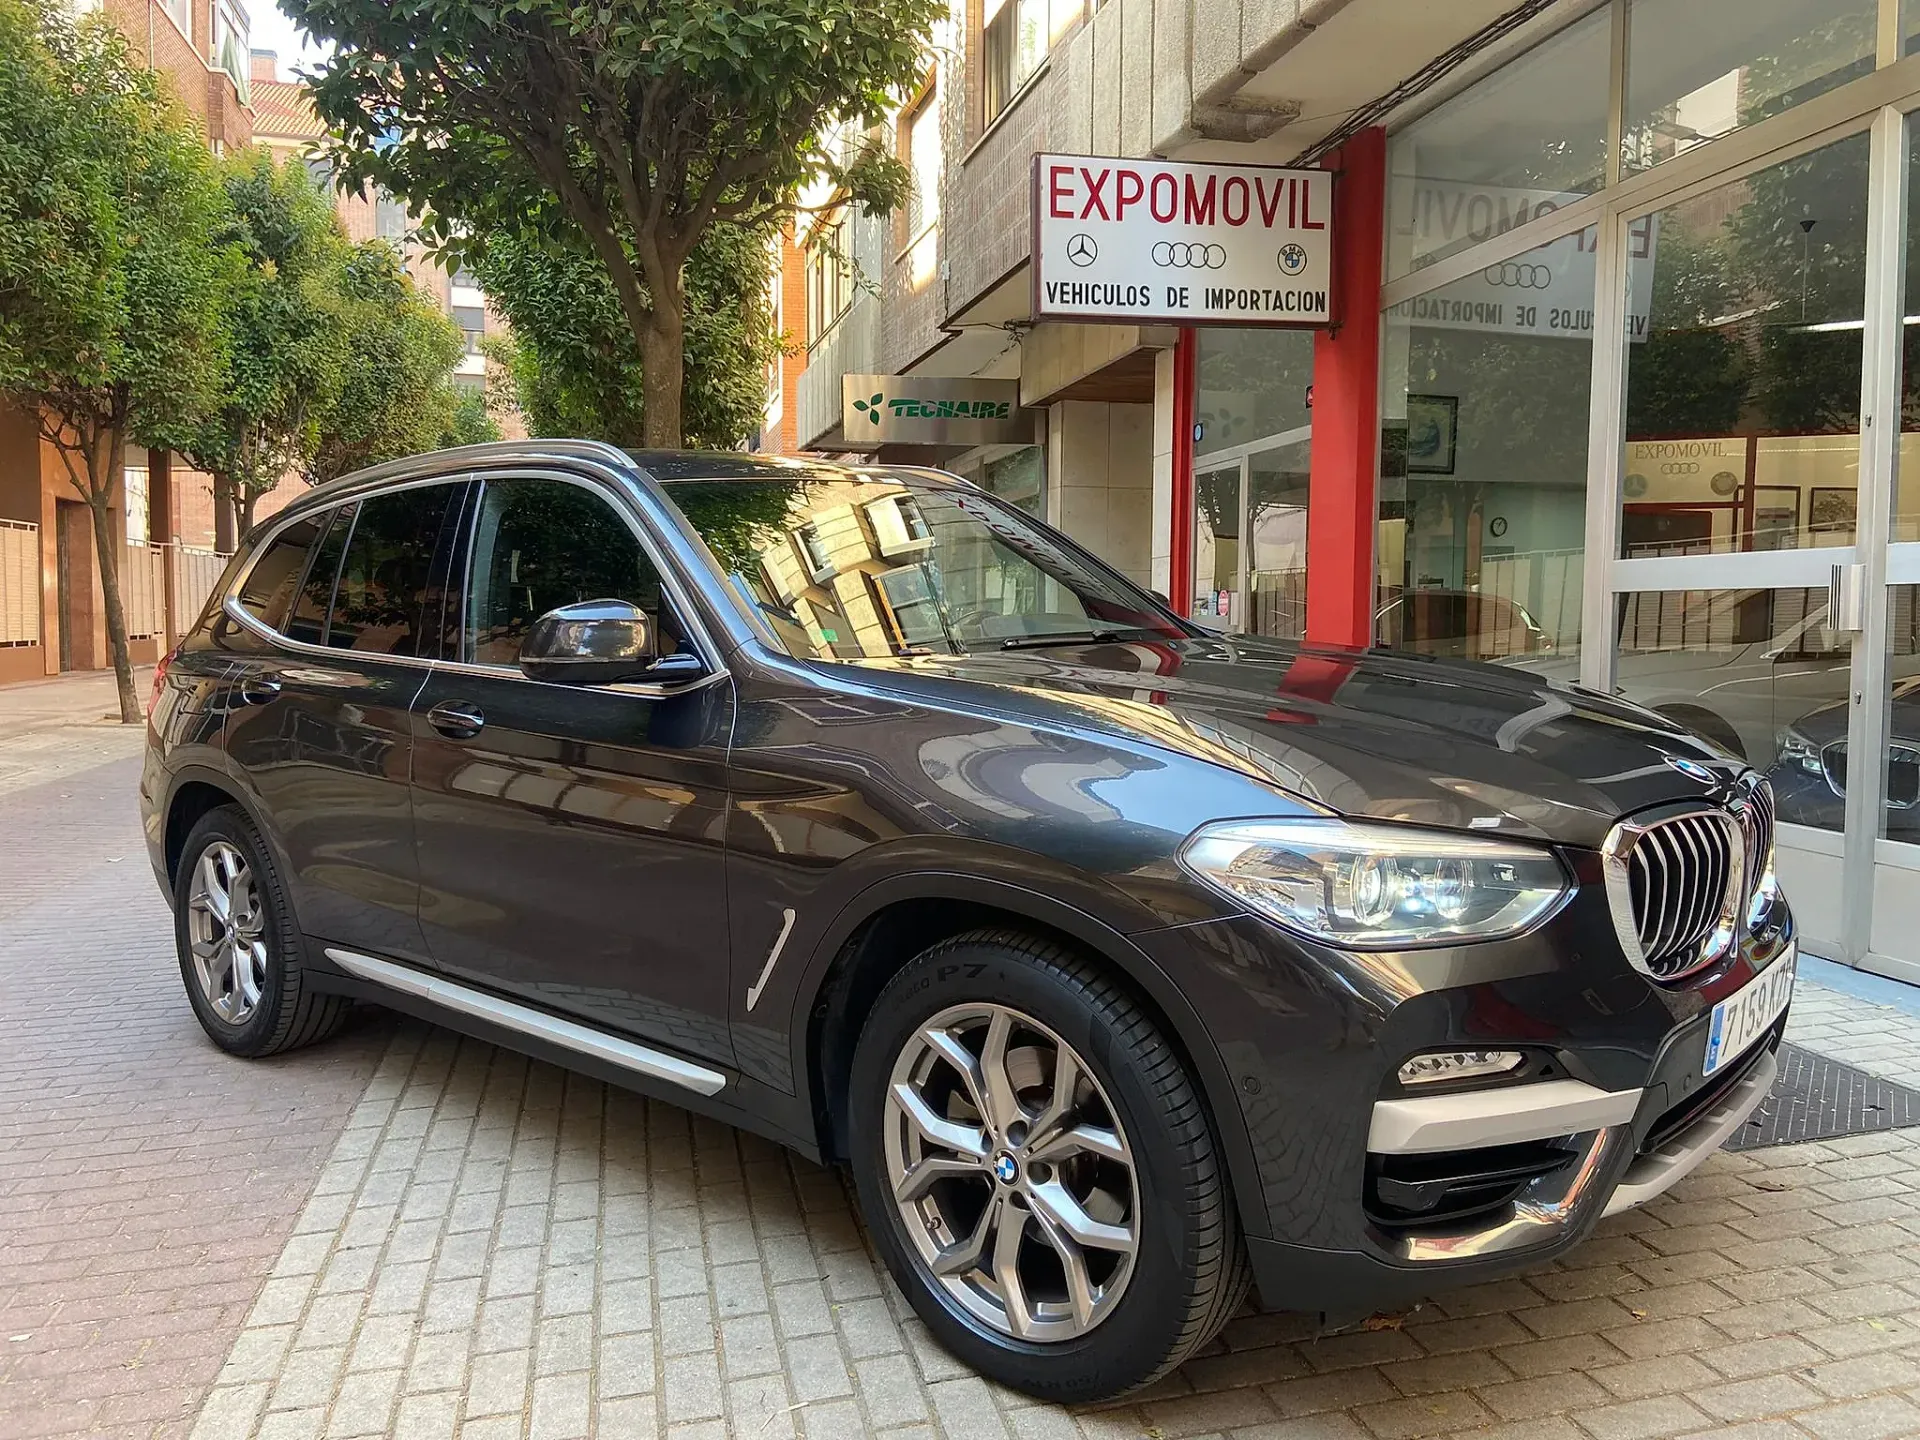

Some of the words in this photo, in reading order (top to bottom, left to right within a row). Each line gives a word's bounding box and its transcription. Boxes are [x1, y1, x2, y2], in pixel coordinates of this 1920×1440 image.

[1049, 165, 1325, 230] EXPOMOVIL
[1281, 246, 1304, 257] BMW
[1046, 281, 1150, 307] VEHICULOS
[1167, 286, 1189, 309] DE
[1205, 288, 1326, 313] IMPORTACION
[887, 399, 1012, 420] TECNAIRE
[1634, 442, 1728, 460] EXPOMOVIL
[937, 963, 989, 983] P7
[1722, 982, 1767, 1057] 7159
